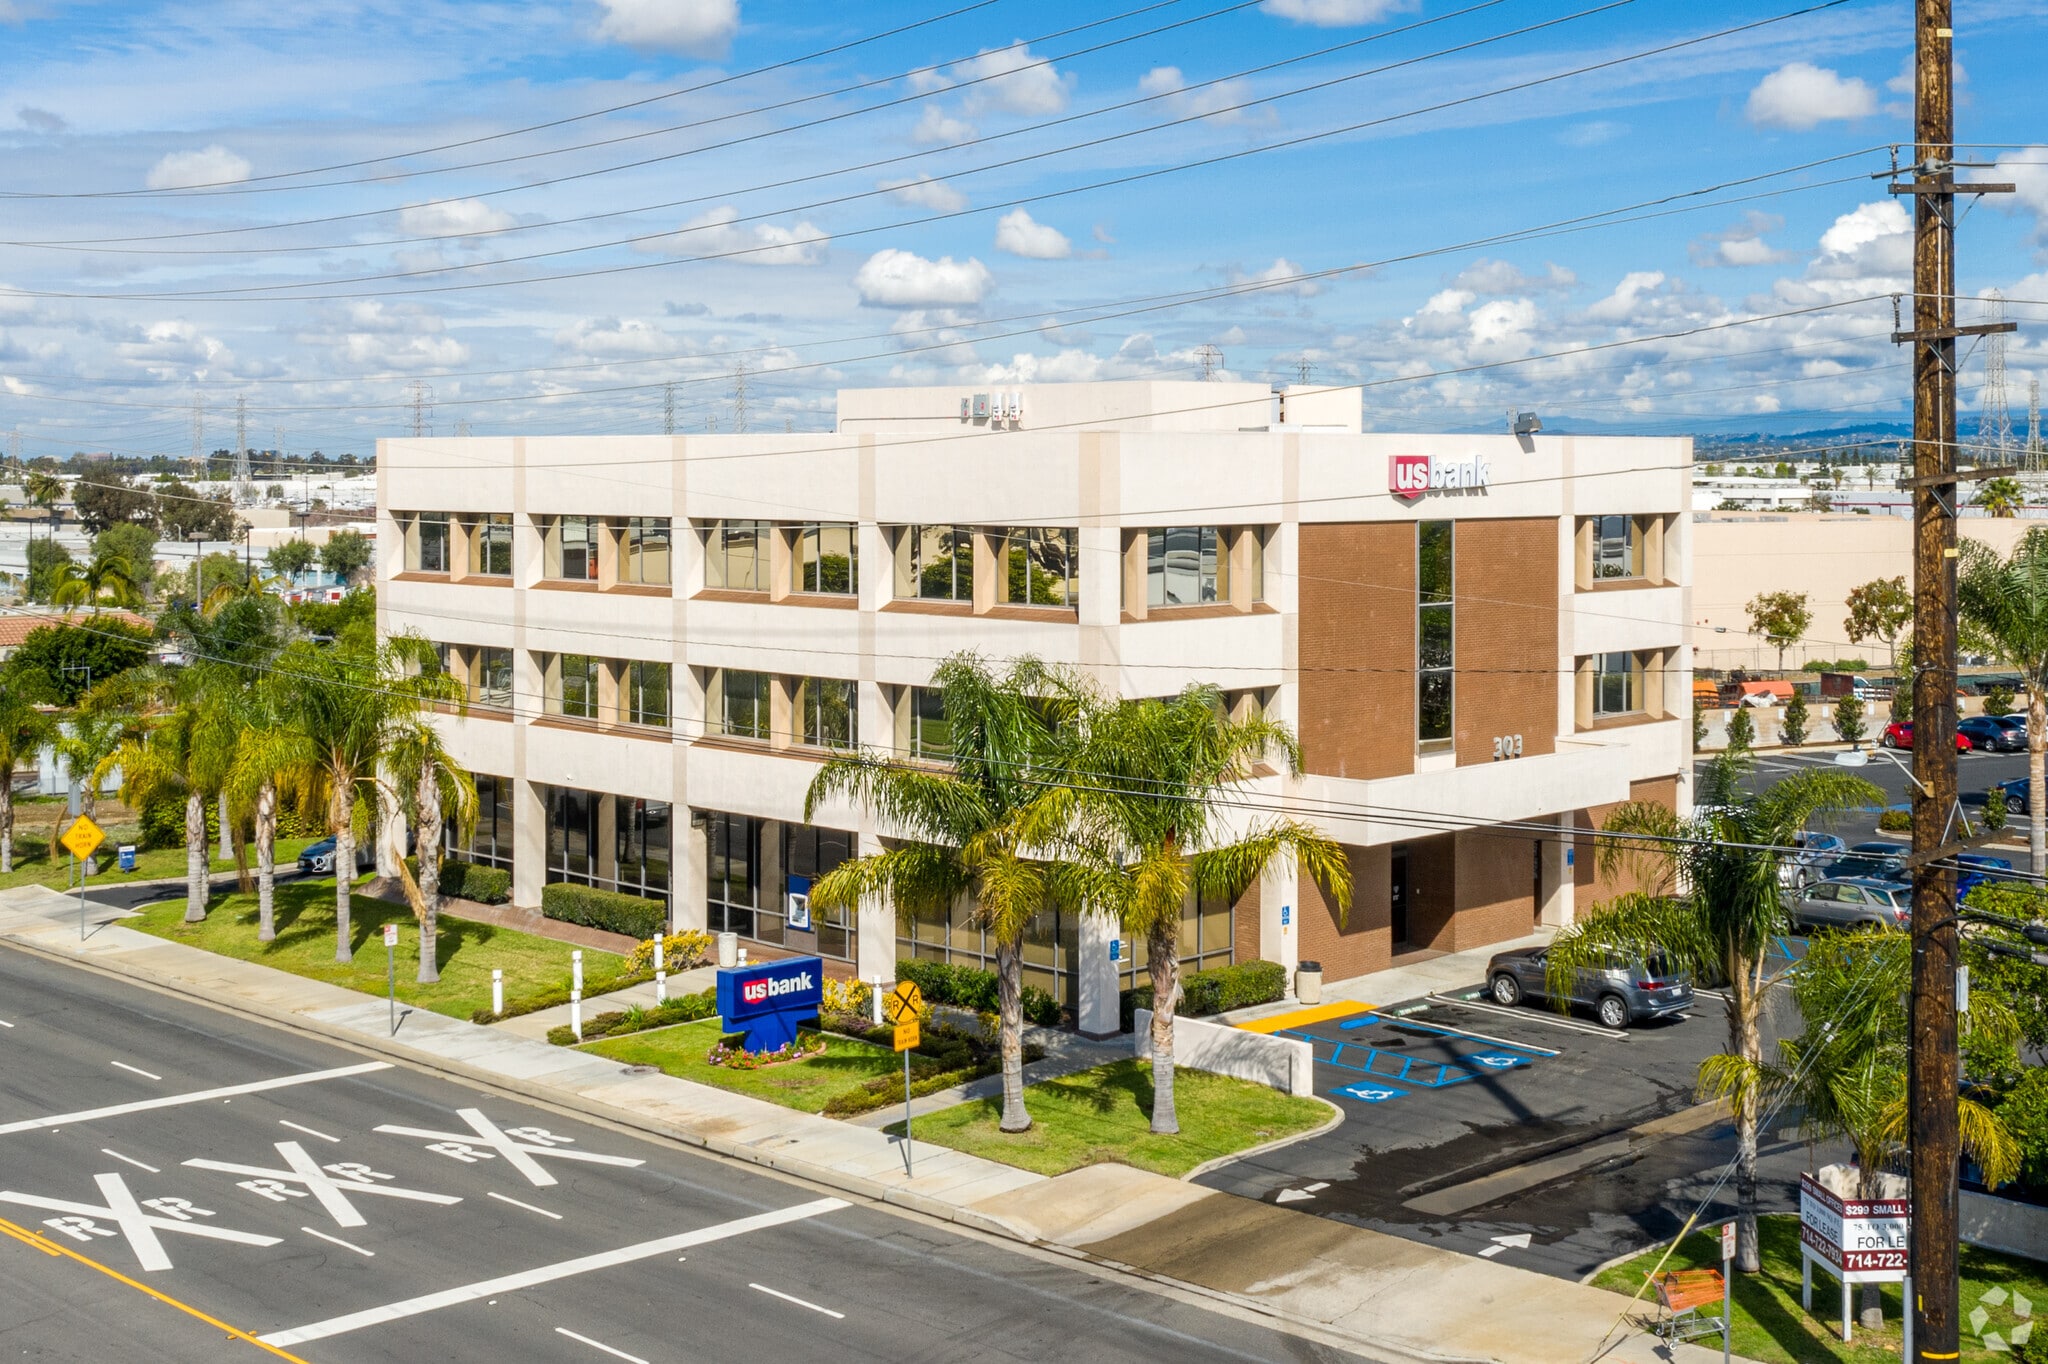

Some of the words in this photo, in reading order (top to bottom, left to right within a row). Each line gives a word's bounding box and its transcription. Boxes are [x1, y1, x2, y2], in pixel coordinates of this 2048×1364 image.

[1493, 734, 1523, 757] 303
[893, 1000, 899, 1010] R
[912, 994, 919, 1005] R
[504, 1126, 574, 1146] R
[424, 1142, 496, 1163] R
[322, 1162, 396, 1183] R
[236, 1179, 309, 1201] R
[141, 1197, 216, 1220] R
[1826, 1195, 1843, 1213] OFFICES
[1845, 1205, 1869, 1216] $299
[1873, 1204, 1905, 1215] SMALL
[42, 1216, 118, 1241] R
[1806, 1211, 1818, 1229] FOR
[1819, 1219, 1838, 1243] LEASE
[1858, 1236, 1884, 1248] FOR
[1888, 1235, 1905, 1248] LE
[1846, 1253, 1907, 1268] 714-722-
